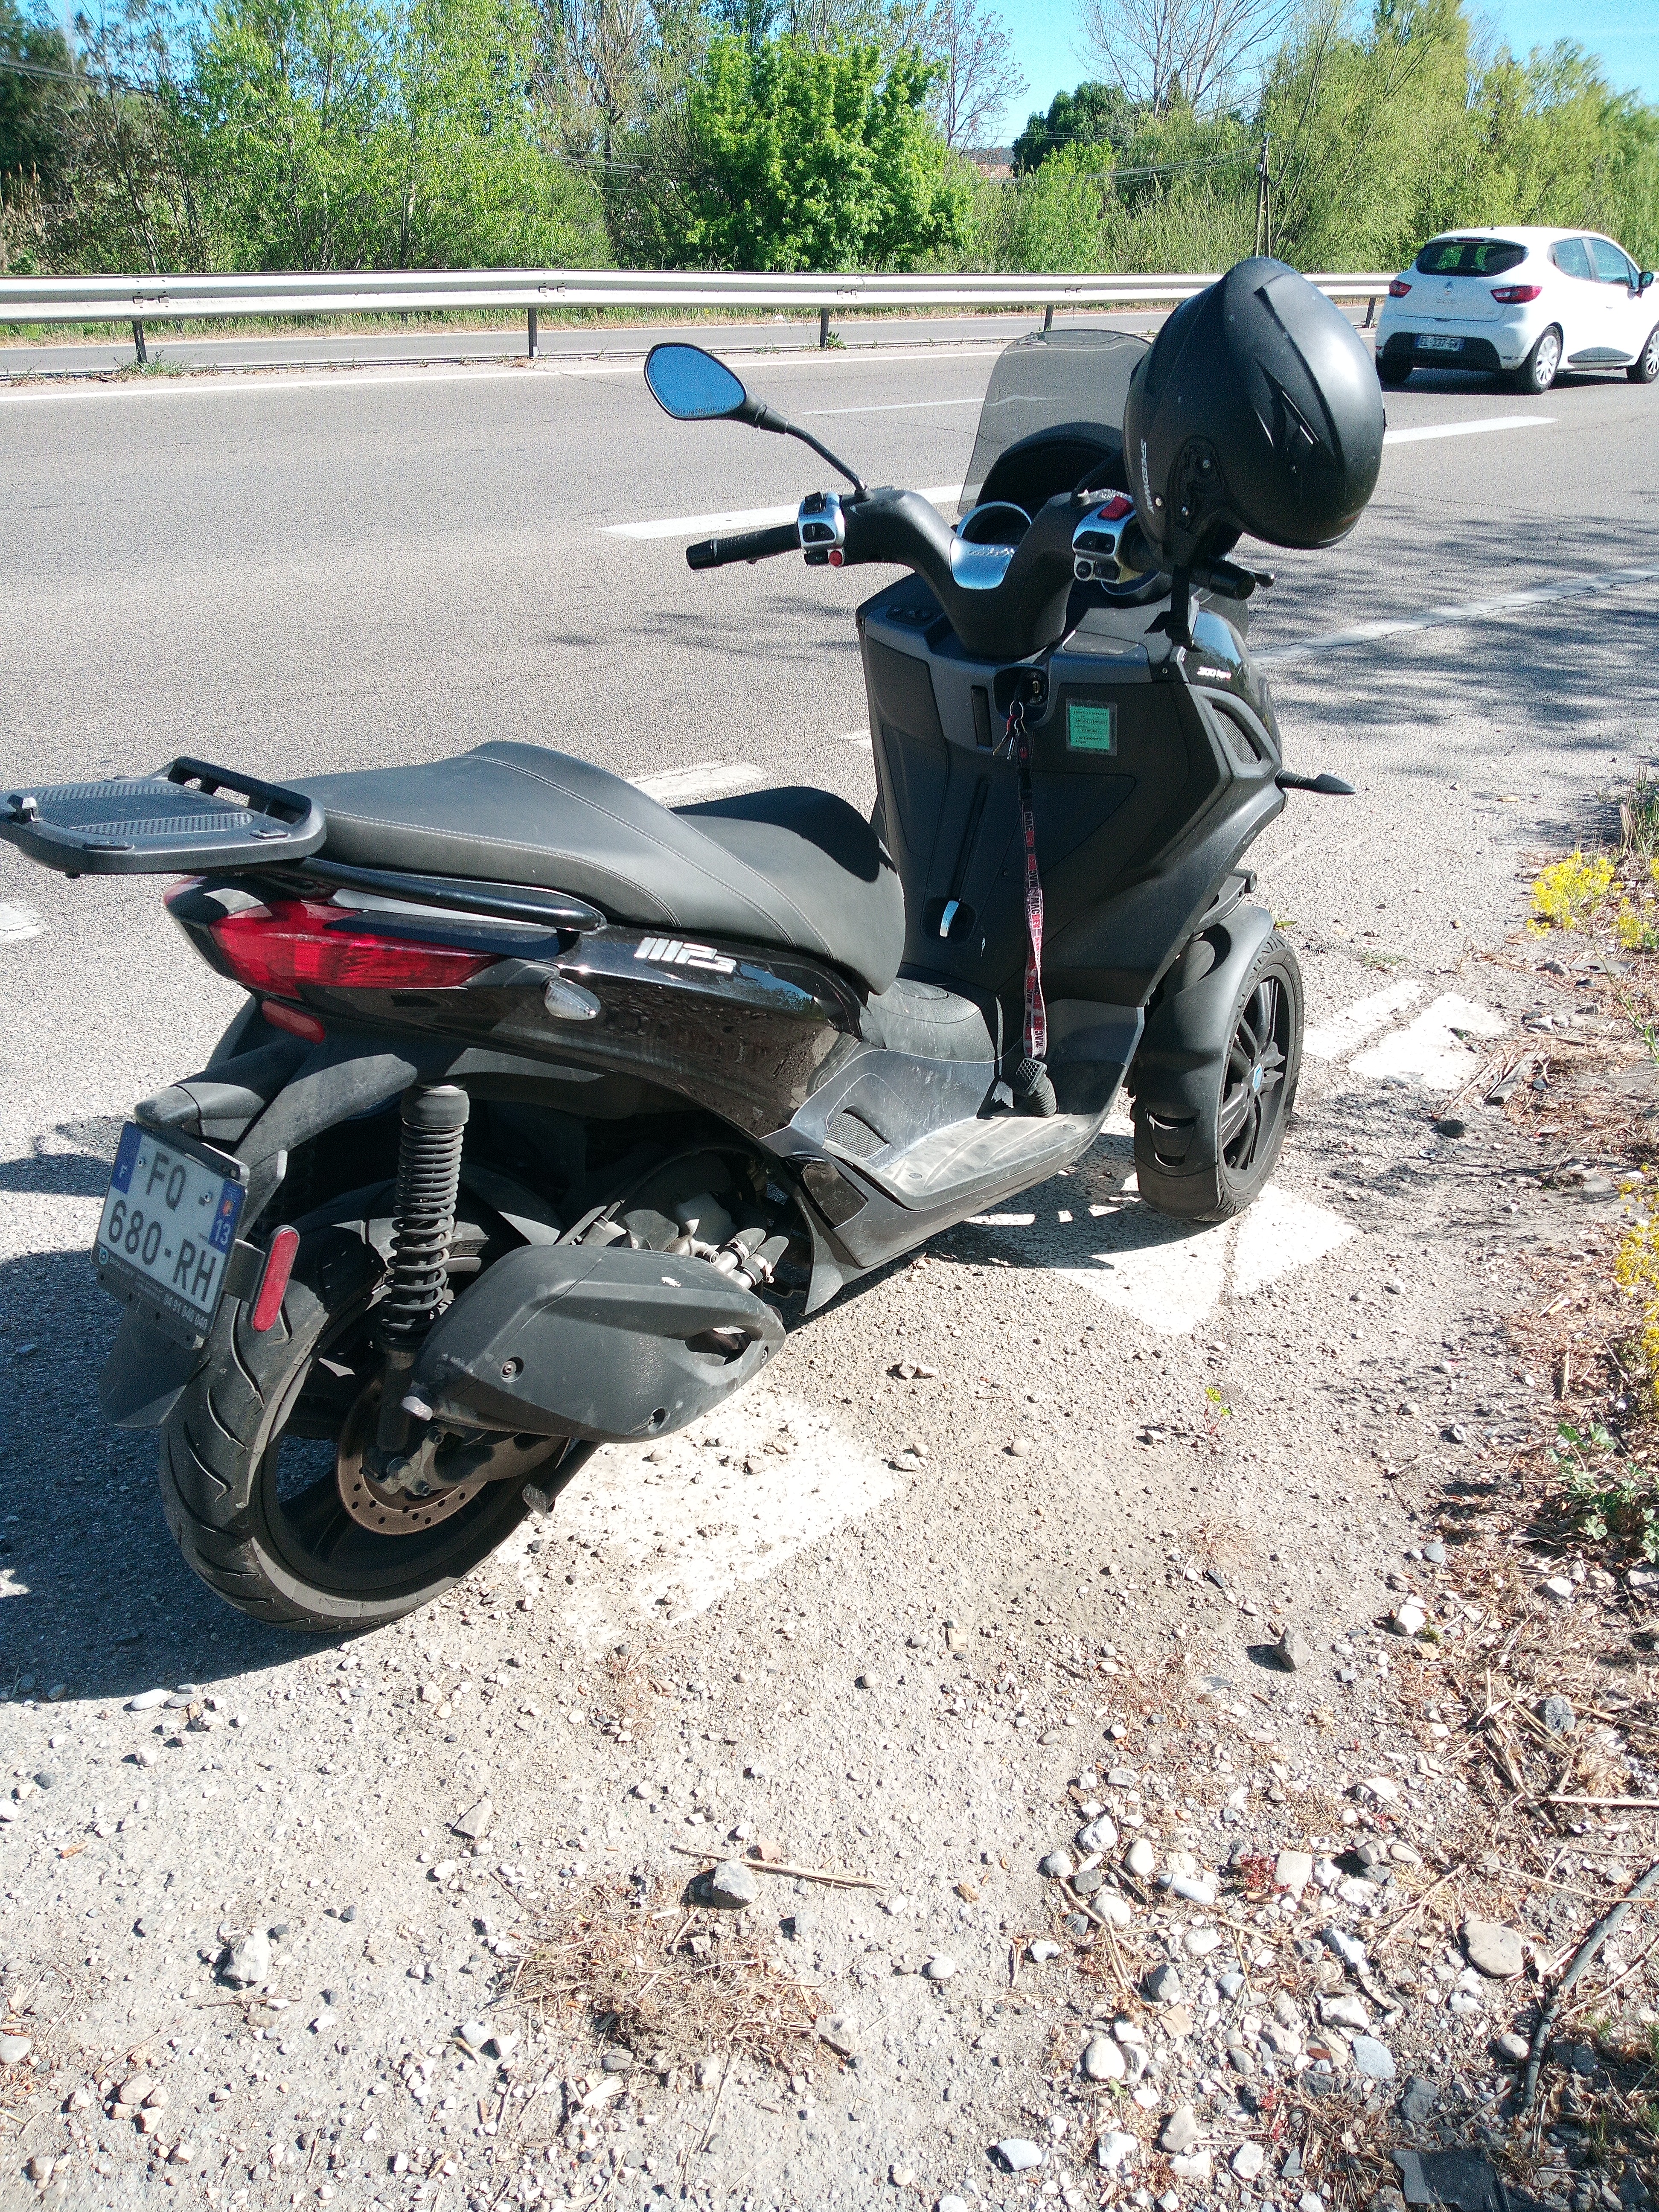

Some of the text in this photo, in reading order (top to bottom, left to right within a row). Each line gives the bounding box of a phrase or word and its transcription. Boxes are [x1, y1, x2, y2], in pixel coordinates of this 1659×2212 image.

[1141, 439, 1155, 514] SPEEDWAY
[1196, 666, 1217, 677] 300
[119, 1164, 128, 1178] F
[215, 1219, 231, 1245] 13
[108, 1199, 216, 1302] 680-RH
